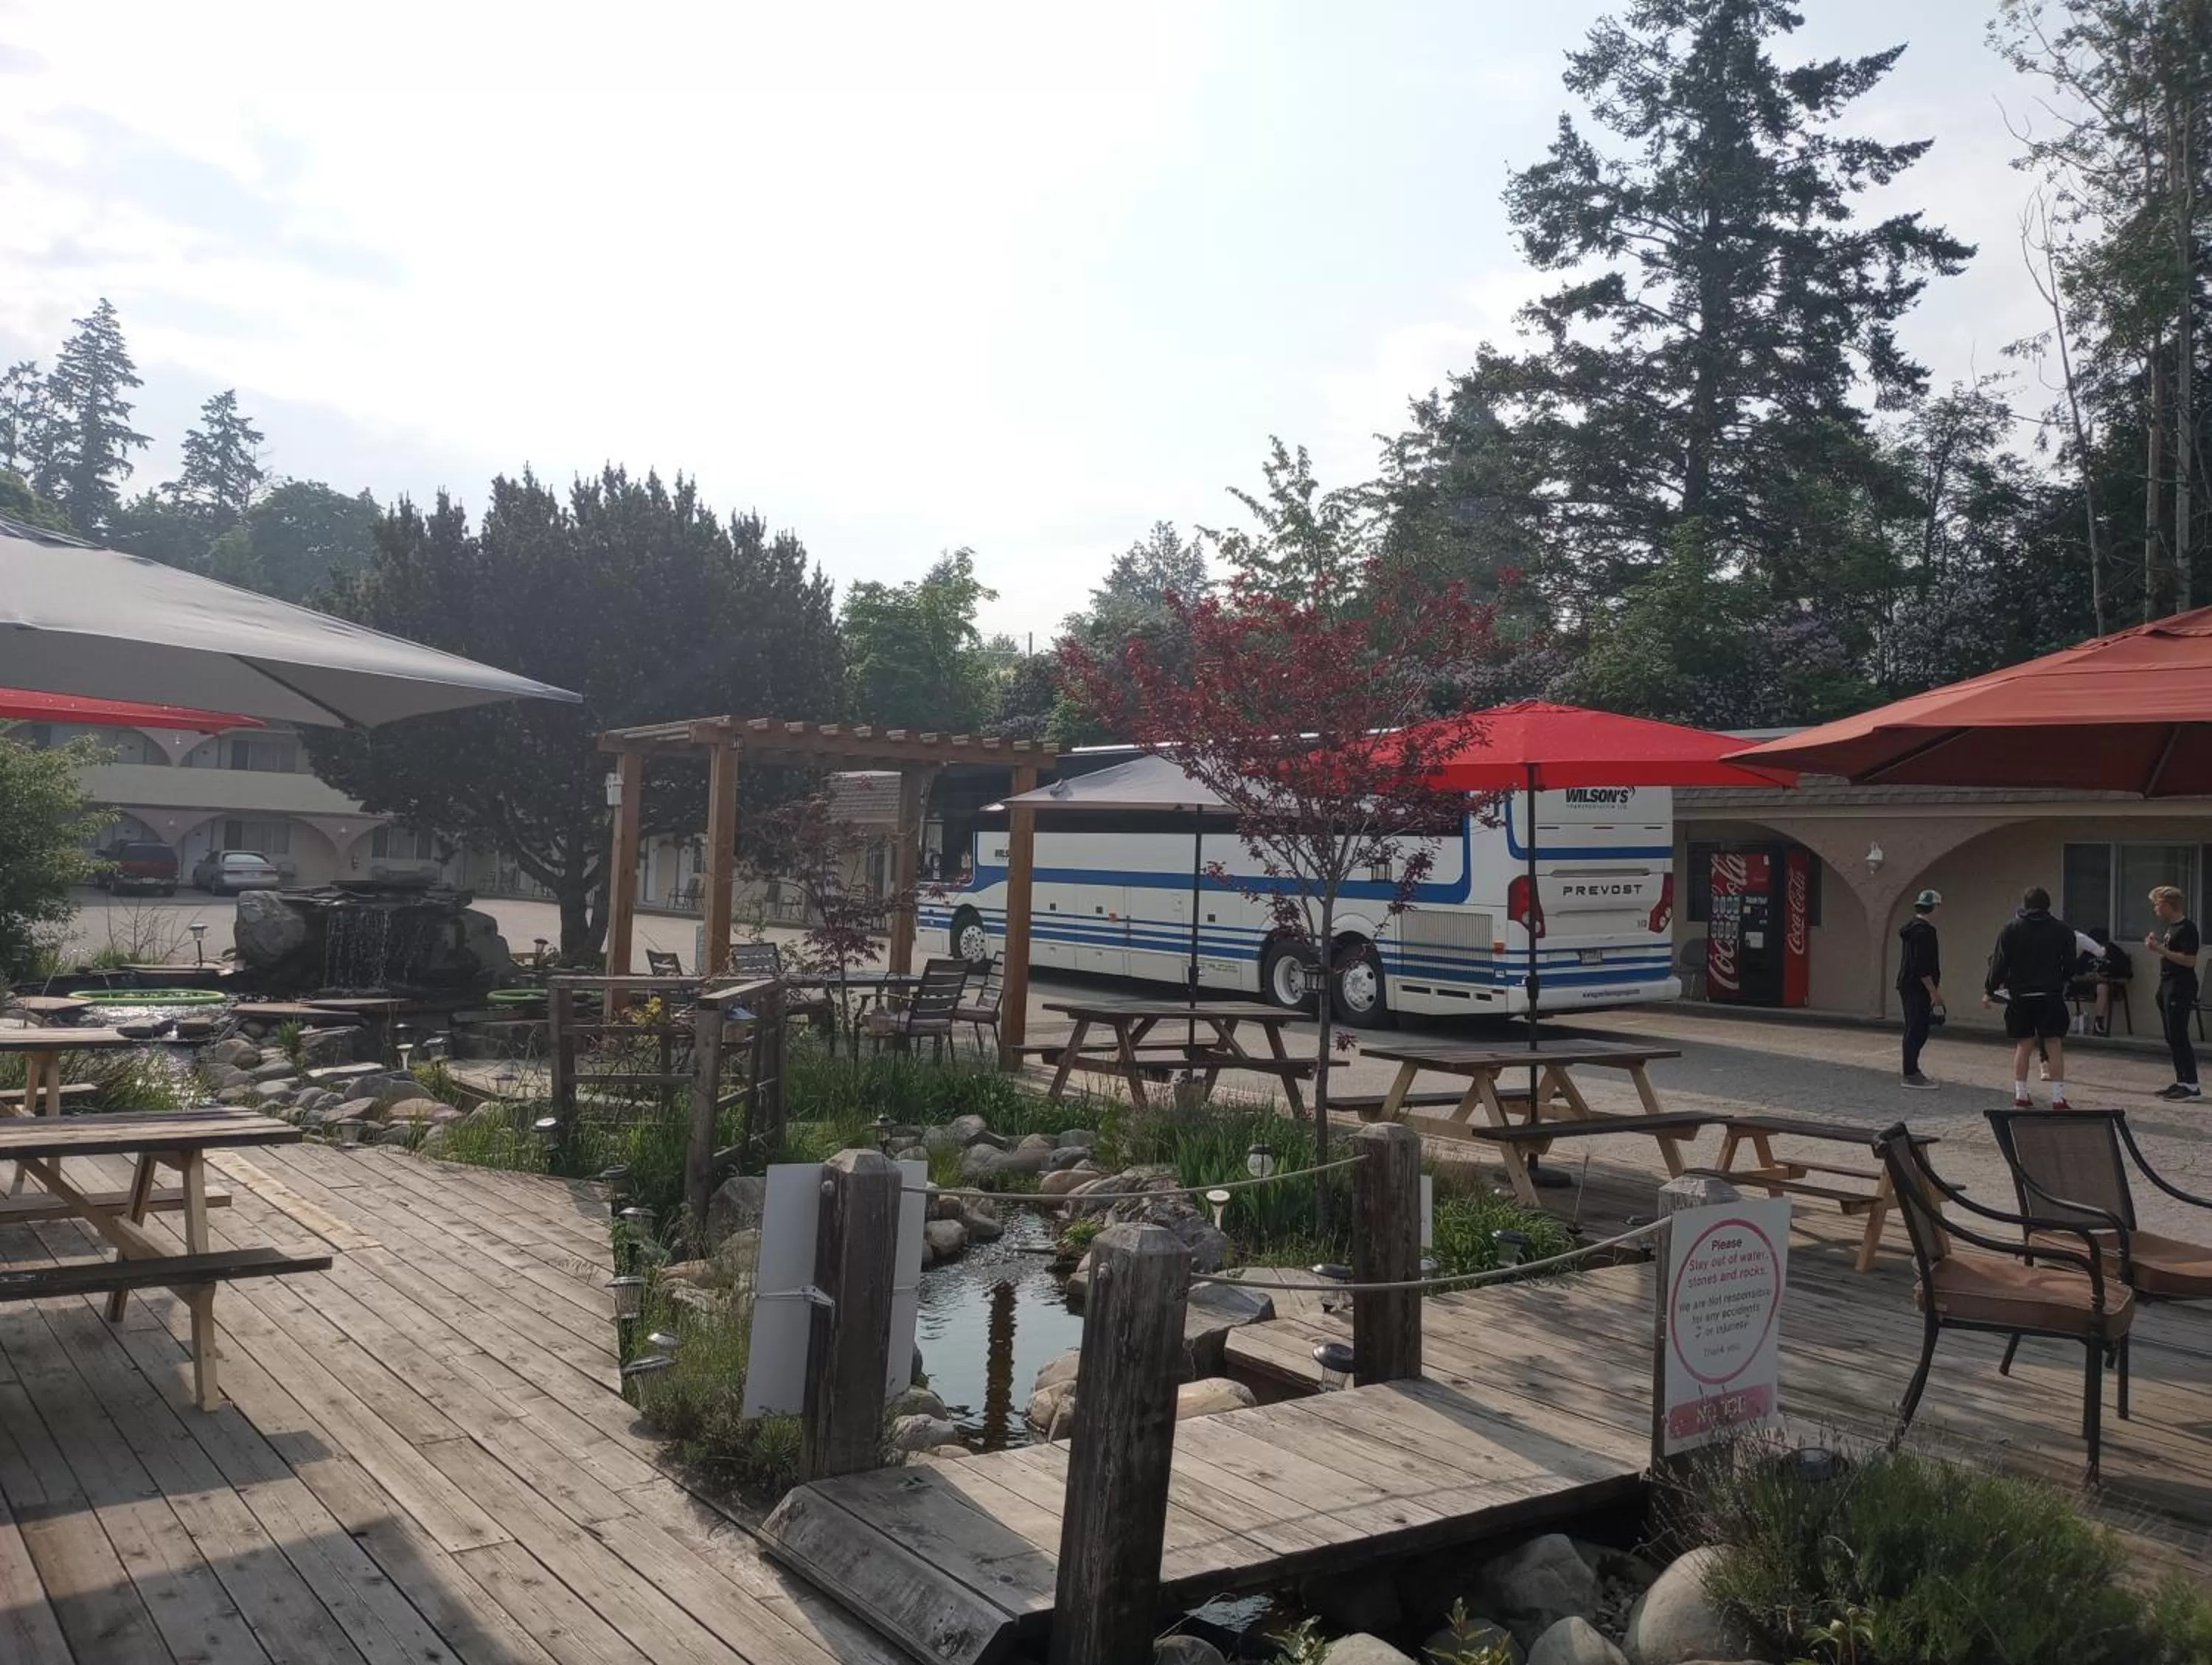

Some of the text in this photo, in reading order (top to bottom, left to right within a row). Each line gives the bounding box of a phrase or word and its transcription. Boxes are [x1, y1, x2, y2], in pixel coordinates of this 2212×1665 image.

[1565, 788, 1629, 803] WILSON'S
[1562, 884, 1643, 896] PREVOST
[1711, 1238, 1742, 1251] Please
[1711, 1254, 1726, 1268] out
[1728, 1252, 1738, 1265] of
[1687, 1273, 1717, 1288] stones
[1720, 1268, 1736, 1282] and
